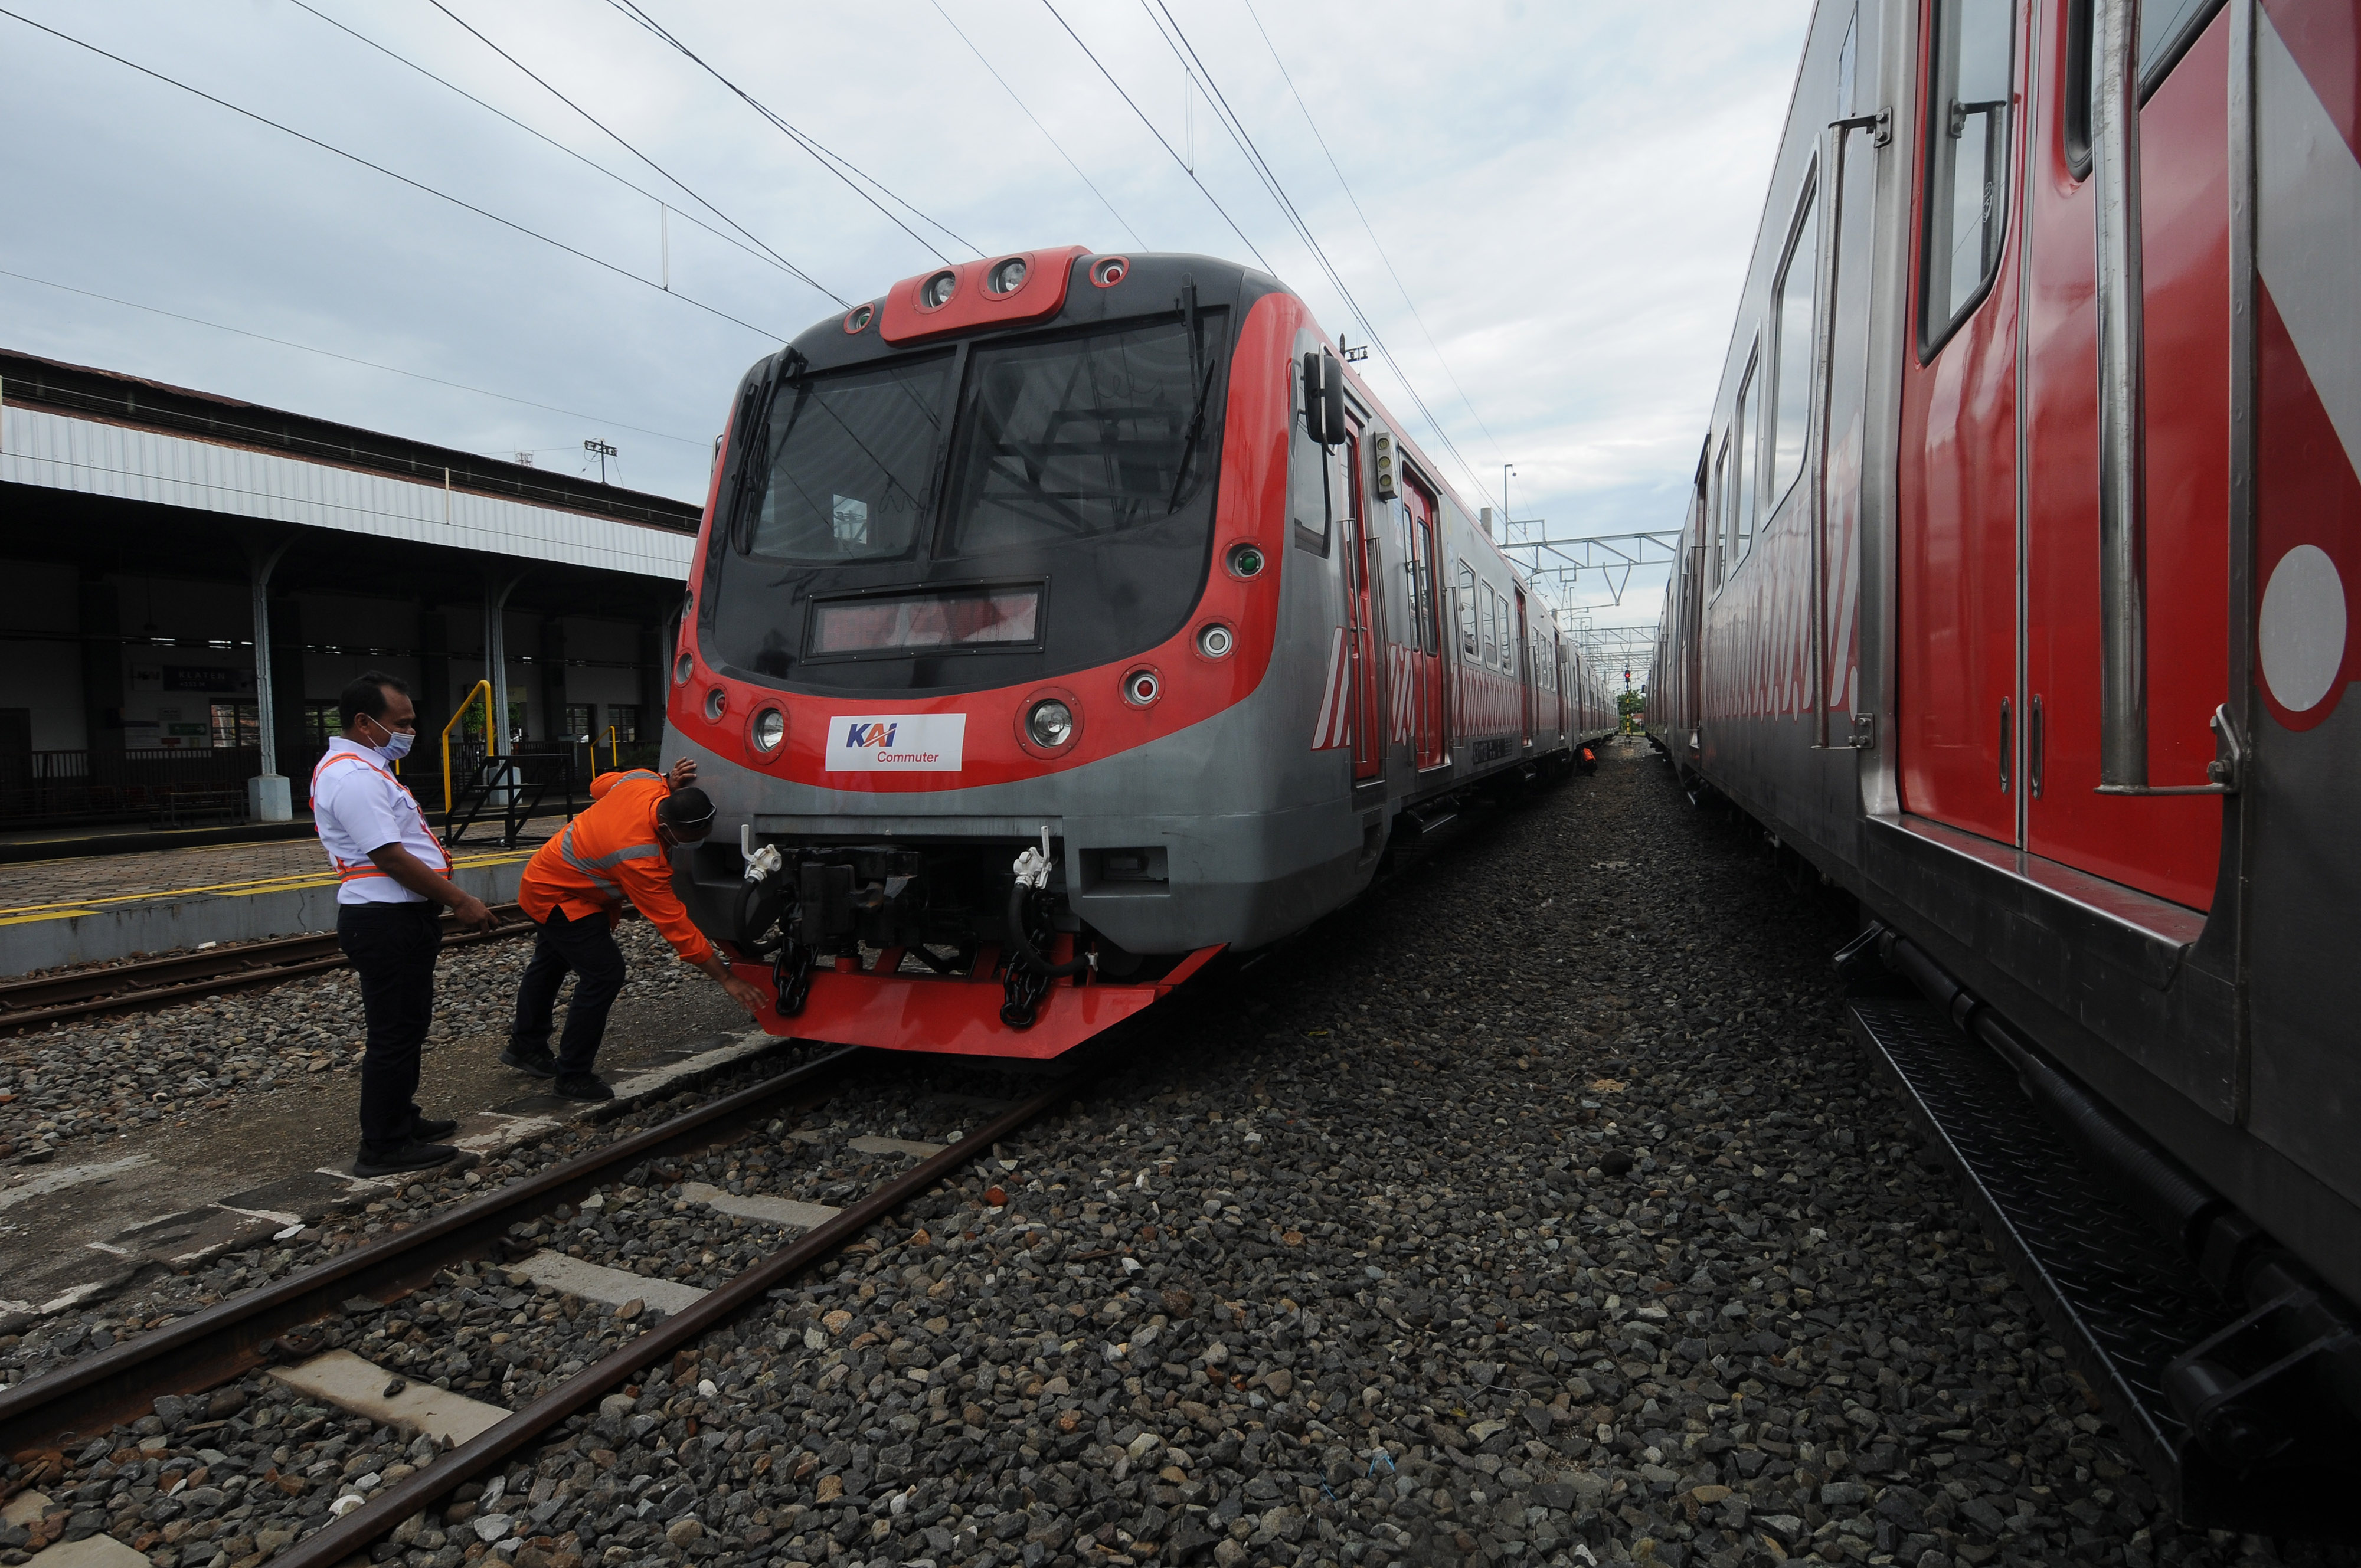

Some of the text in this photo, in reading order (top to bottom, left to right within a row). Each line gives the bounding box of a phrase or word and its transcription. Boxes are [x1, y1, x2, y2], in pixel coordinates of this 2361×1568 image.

[179, 670, 225, 679] KLATEN
[846, 722, 898, 748] KAI
[877, 751, 939, 762] Commuter
